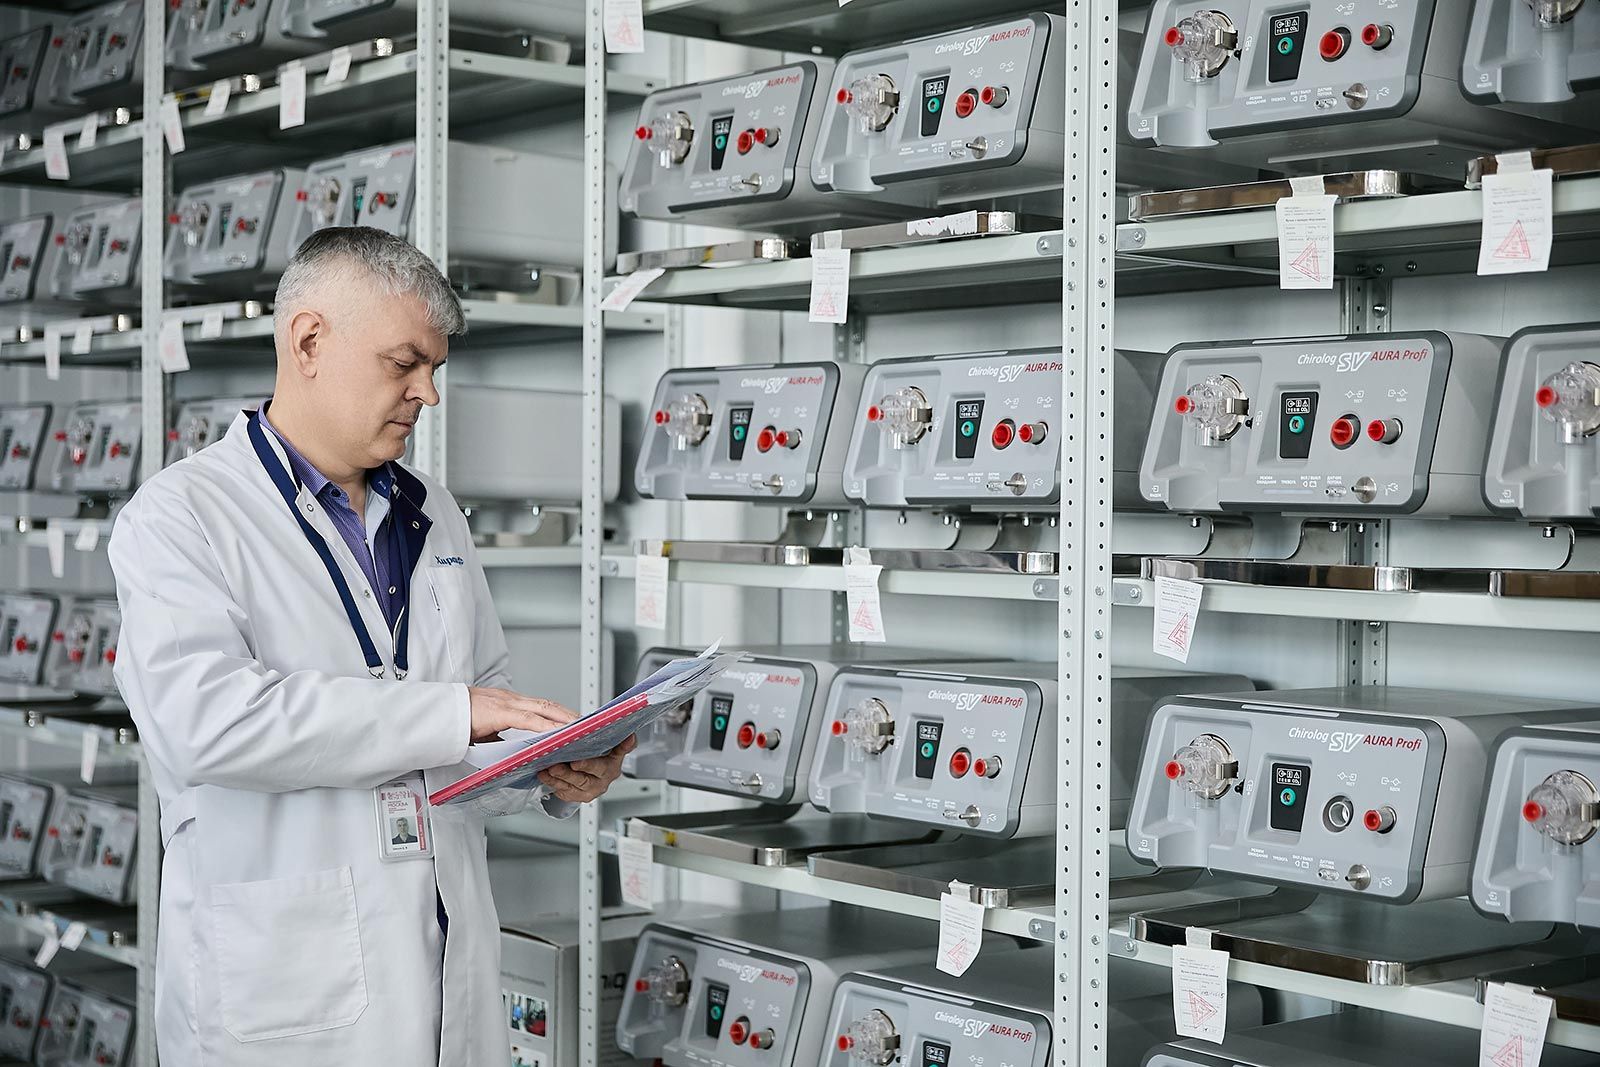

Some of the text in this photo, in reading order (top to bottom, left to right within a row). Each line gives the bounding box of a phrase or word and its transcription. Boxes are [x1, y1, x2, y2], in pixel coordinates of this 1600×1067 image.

[935, 42, 964, 54] Chirolog
[989, 30, 1011, 42] AURA
[1012, 26, 1031, 38] Profi
[1297, 348, 1428, 372] Chirolog SV AURA Profi
[968, 366, 999, 377] Chirolog
[997, 364, 1025, 383] SV
[1025, 363, 1048, 372] AURA
[928, 690, 1023, 711] Chirolog SV AURA Profi
[1288, 727, 1422, 753] Chirolog SV AURA Profi
[935, 1011, 1032, 1043] Chirolog SV AURA Profi
